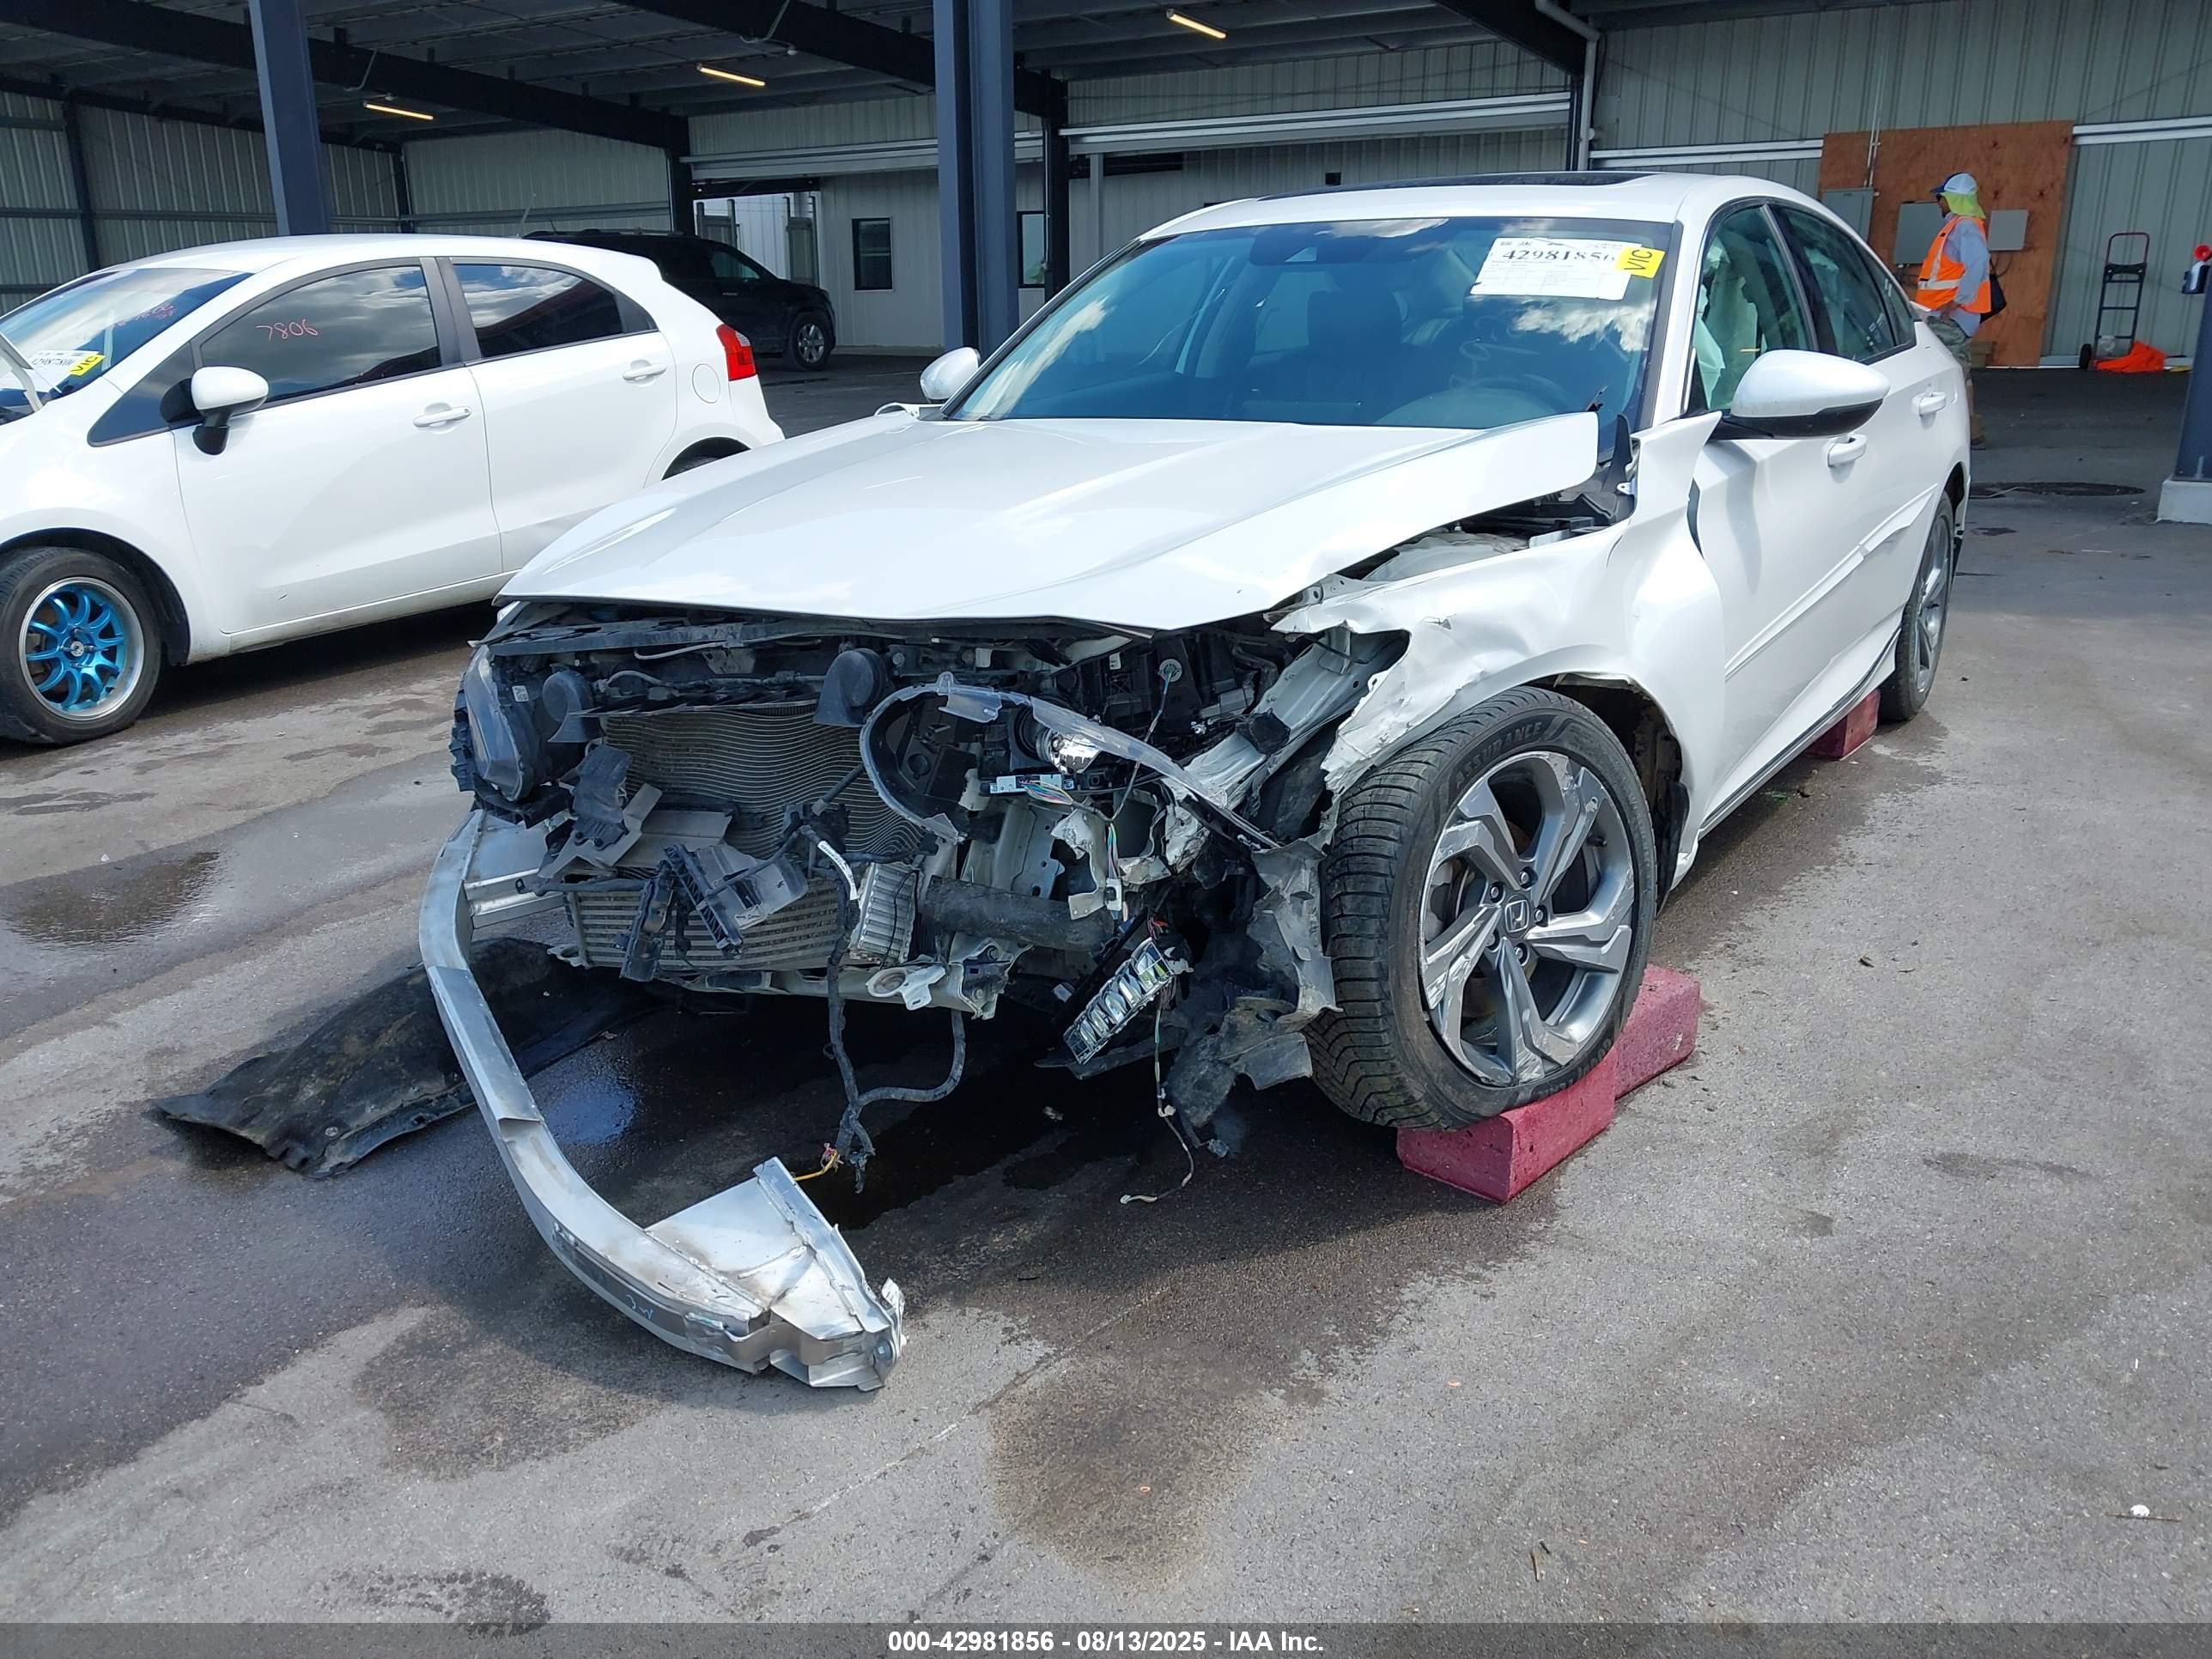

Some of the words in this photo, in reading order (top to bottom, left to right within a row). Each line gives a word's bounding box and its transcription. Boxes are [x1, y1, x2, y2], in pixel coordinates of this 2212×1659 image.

[1623, 249, 1653, 270] VIC
[255, 319, 319, 340] 7806
[70, 356, 99, 373] VIC
